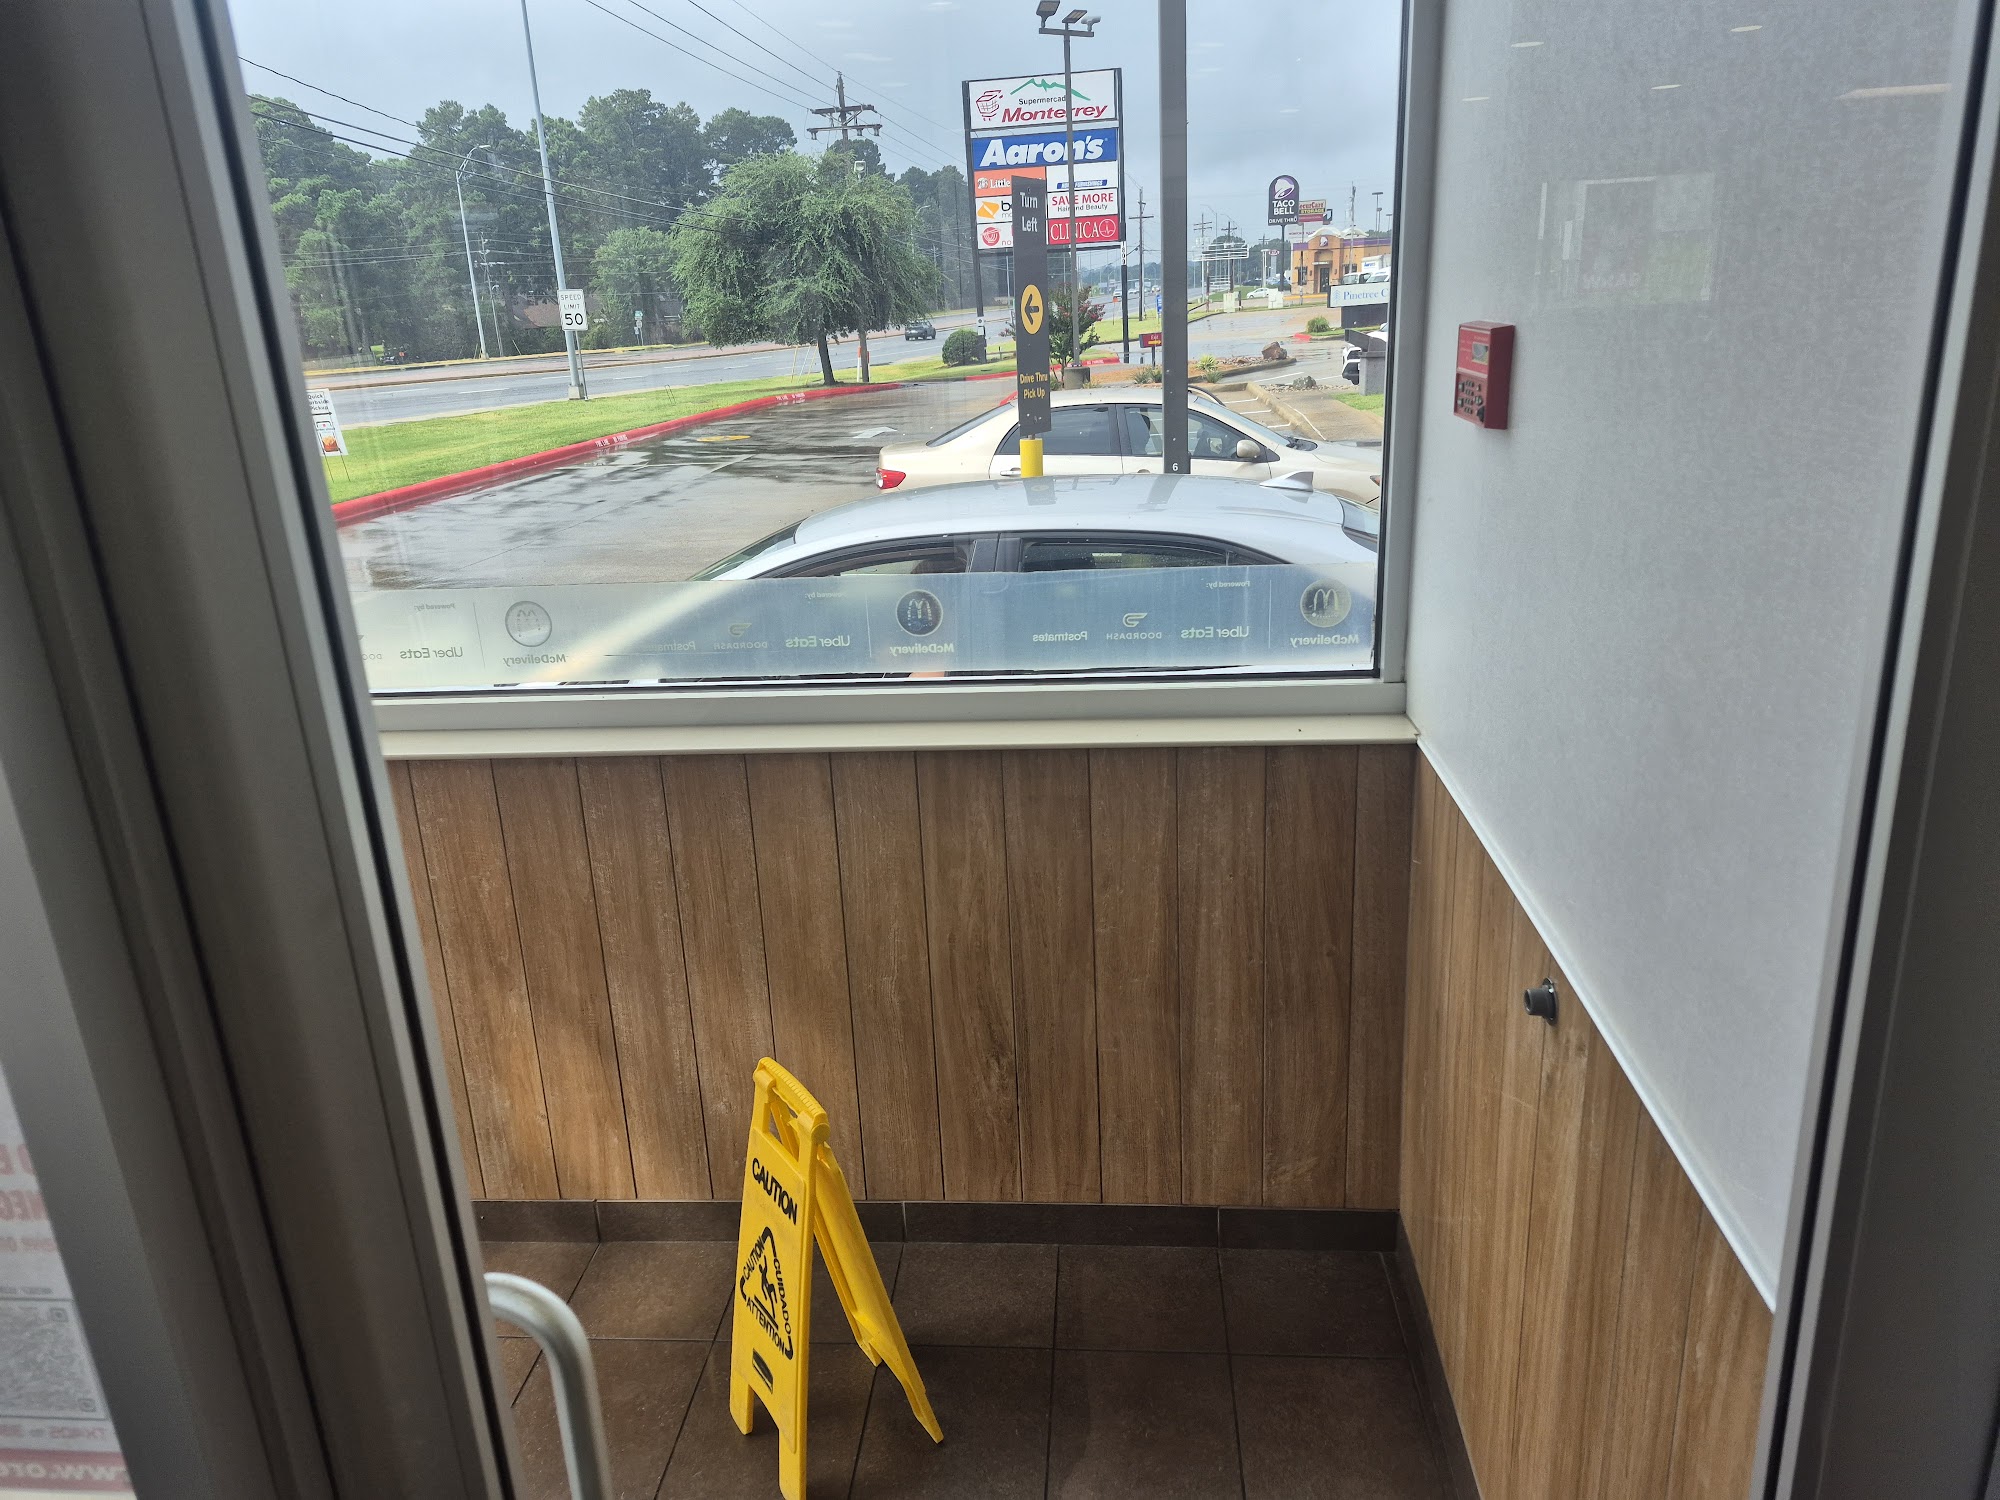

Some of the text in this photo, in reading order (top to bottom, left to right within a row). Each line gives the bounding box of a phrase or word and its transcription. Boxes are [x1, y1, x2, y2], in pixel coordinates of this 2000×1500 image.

[1019, 95, 1066, 106] Supermercad
[979, 135, 1104, 167] Aaron's
[990, 178, 1011, 189] Little
[1020, 192, 1038, 209] Turn
[1082, 193, 1114, 204] MORE
[1272, 200, 1295, 208] TACO
[1273, 207, 1295, 215] BELL
[1022, 216, 1038, 232] Left
[1343, 290, 1379, 300] Pinetree
[564, 313, 584, 326] 50
[1020, 371, 1048, 384] Drive Thru
[1023, 387, 1046, 399] Pick Up
[1172, 462, 1179, 471] 6
[752, 1157, 798, 1225] CAUTION
[743, 1235, 765, 1281] CAUTION
[773, 1257, 792, 1335] CUIDADO
[746, 1296, 785, 1356] ATTENTION
